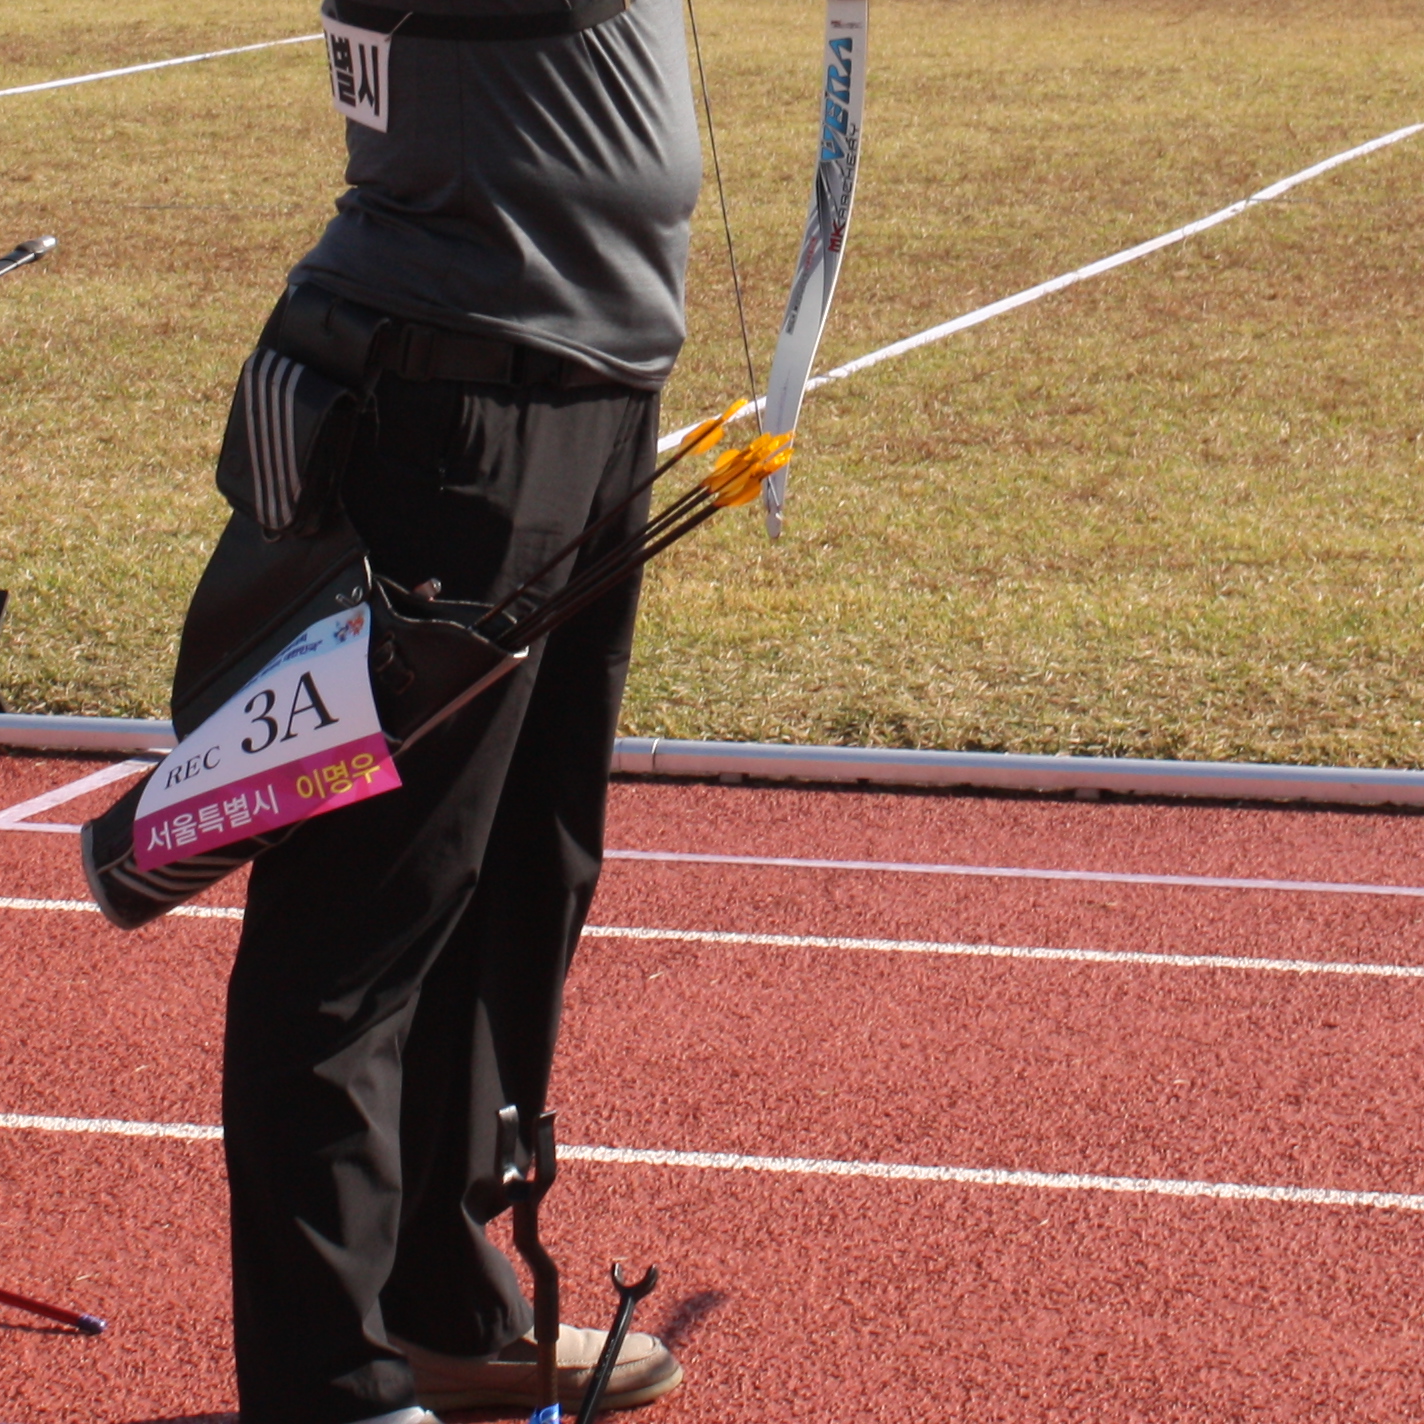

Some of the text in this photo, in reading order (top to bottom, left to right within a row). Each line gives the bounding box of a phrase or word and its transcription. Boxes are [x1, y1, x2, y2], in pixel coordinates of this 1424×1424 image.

[324, 29, 380, 117] 별시
[819, 36, 854, 164] VERA
[826, 122, 861, 254] MK ARCHERY
[164, 745, 222, 791] REC
[240, 670, 340, 754] 3A
[146, 752, 382, 852] 서울특별시 이명우
